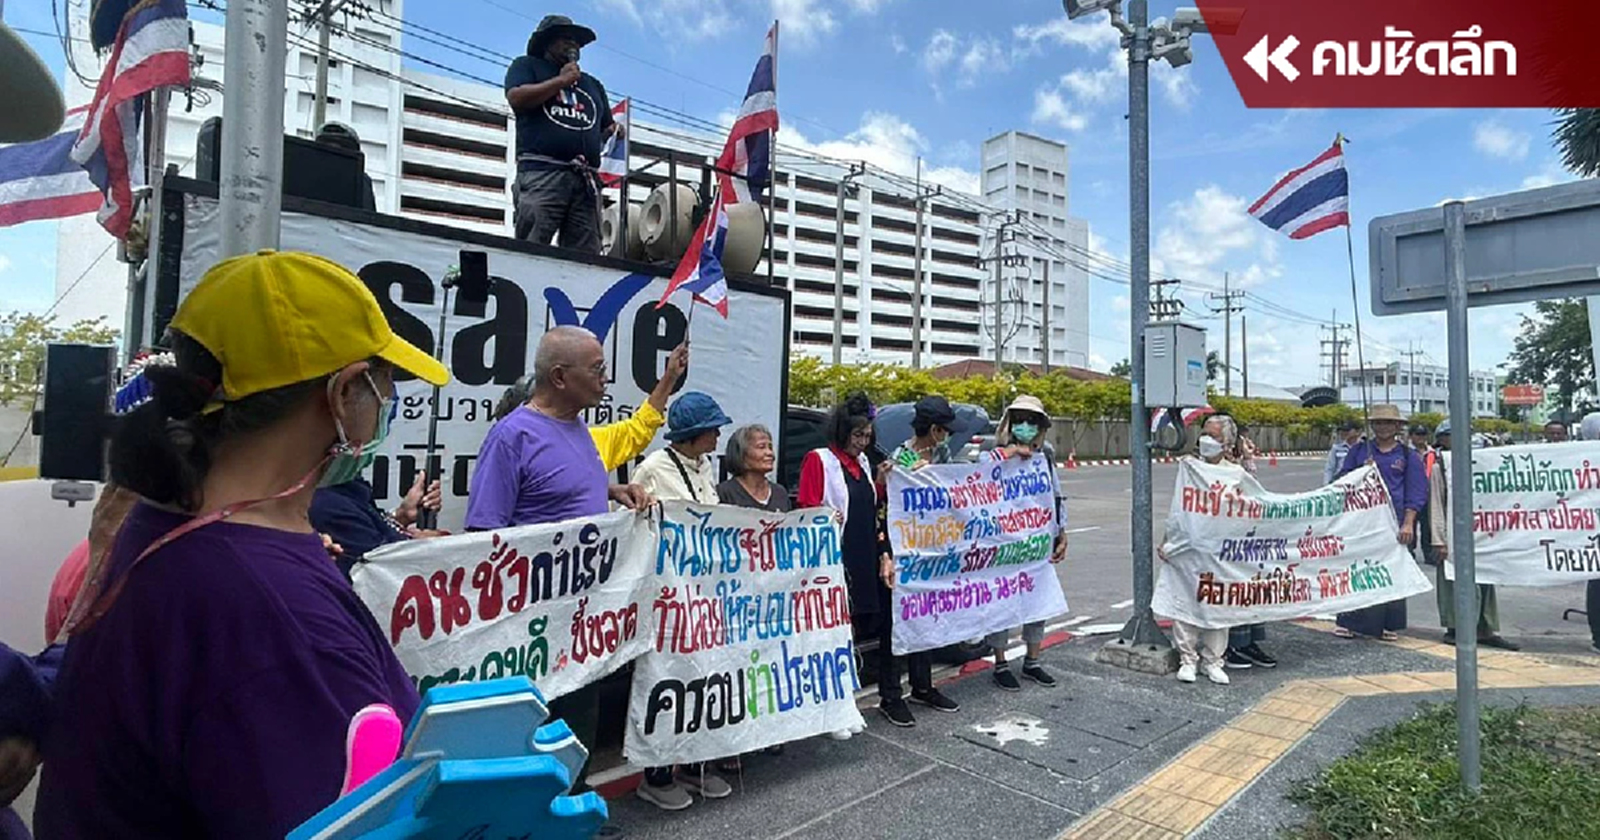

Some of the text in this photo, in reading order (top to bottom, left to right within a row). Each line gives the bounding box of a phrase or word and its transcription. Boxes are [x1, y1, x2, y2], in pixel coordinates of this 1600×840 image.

[644, 640, 862, 736] ครอบงำประเทศ
